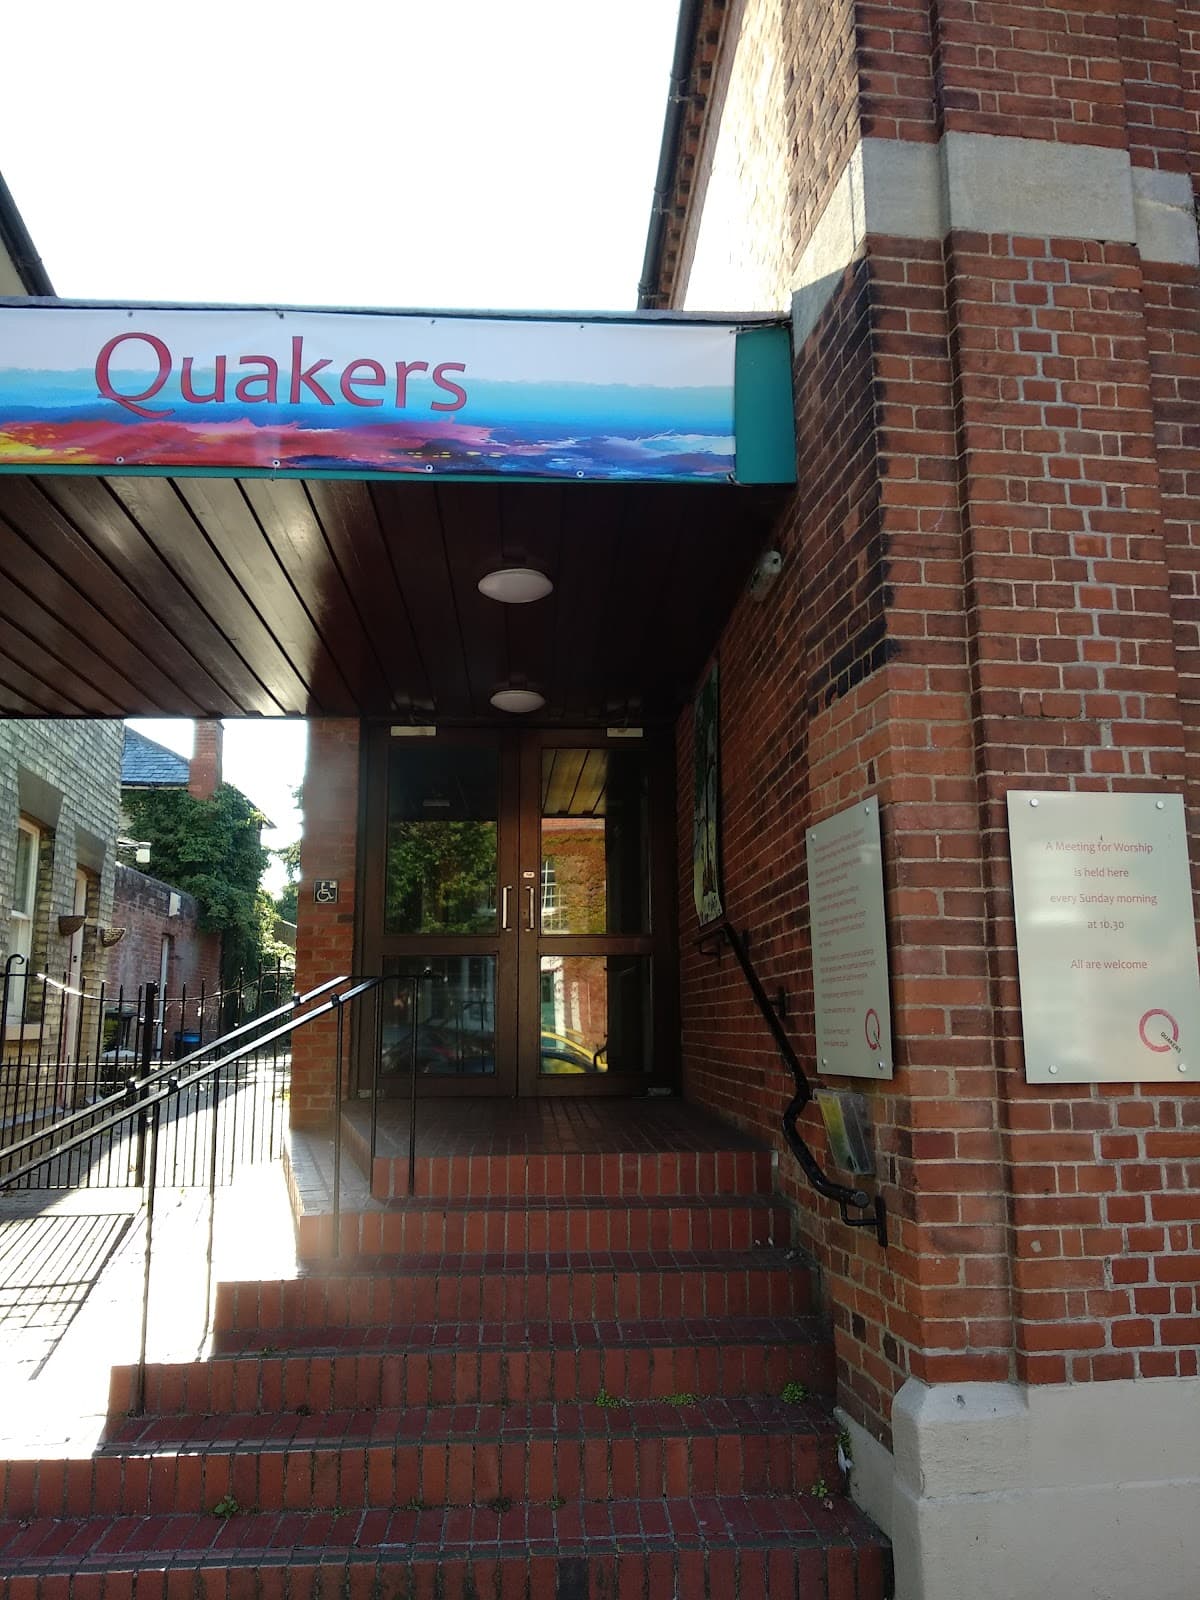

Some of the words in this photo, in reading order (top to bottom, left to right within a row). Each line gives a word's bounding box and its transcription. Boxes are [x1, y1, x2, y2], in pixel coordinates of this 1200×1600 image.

[95, 332, 467, 418] Quakers
[1046, 842, 1053, 851] A
[1056, 841, 1095, 854] Meeting
[1097, 842, 1111, 852] for
[1113, 842, 1153, 854] Worship
[1074, 868, 1081, 877] is
[1083, 867, 1104, 877] held
[1107, 868, 1129, 877] here
[1050, 895, 1077, 905] every
[1079, 894, 1114, 905] Sunday
[1116, 895, 1158, 906] morning
[1087, 921, 1097, 929] at
[1100, 921, 1125, 931] 10.30
[1070, 959, 1083, 969] All
[1085, 961, 1101, 969] are
[1104, 960, 1148, 969] welcome
